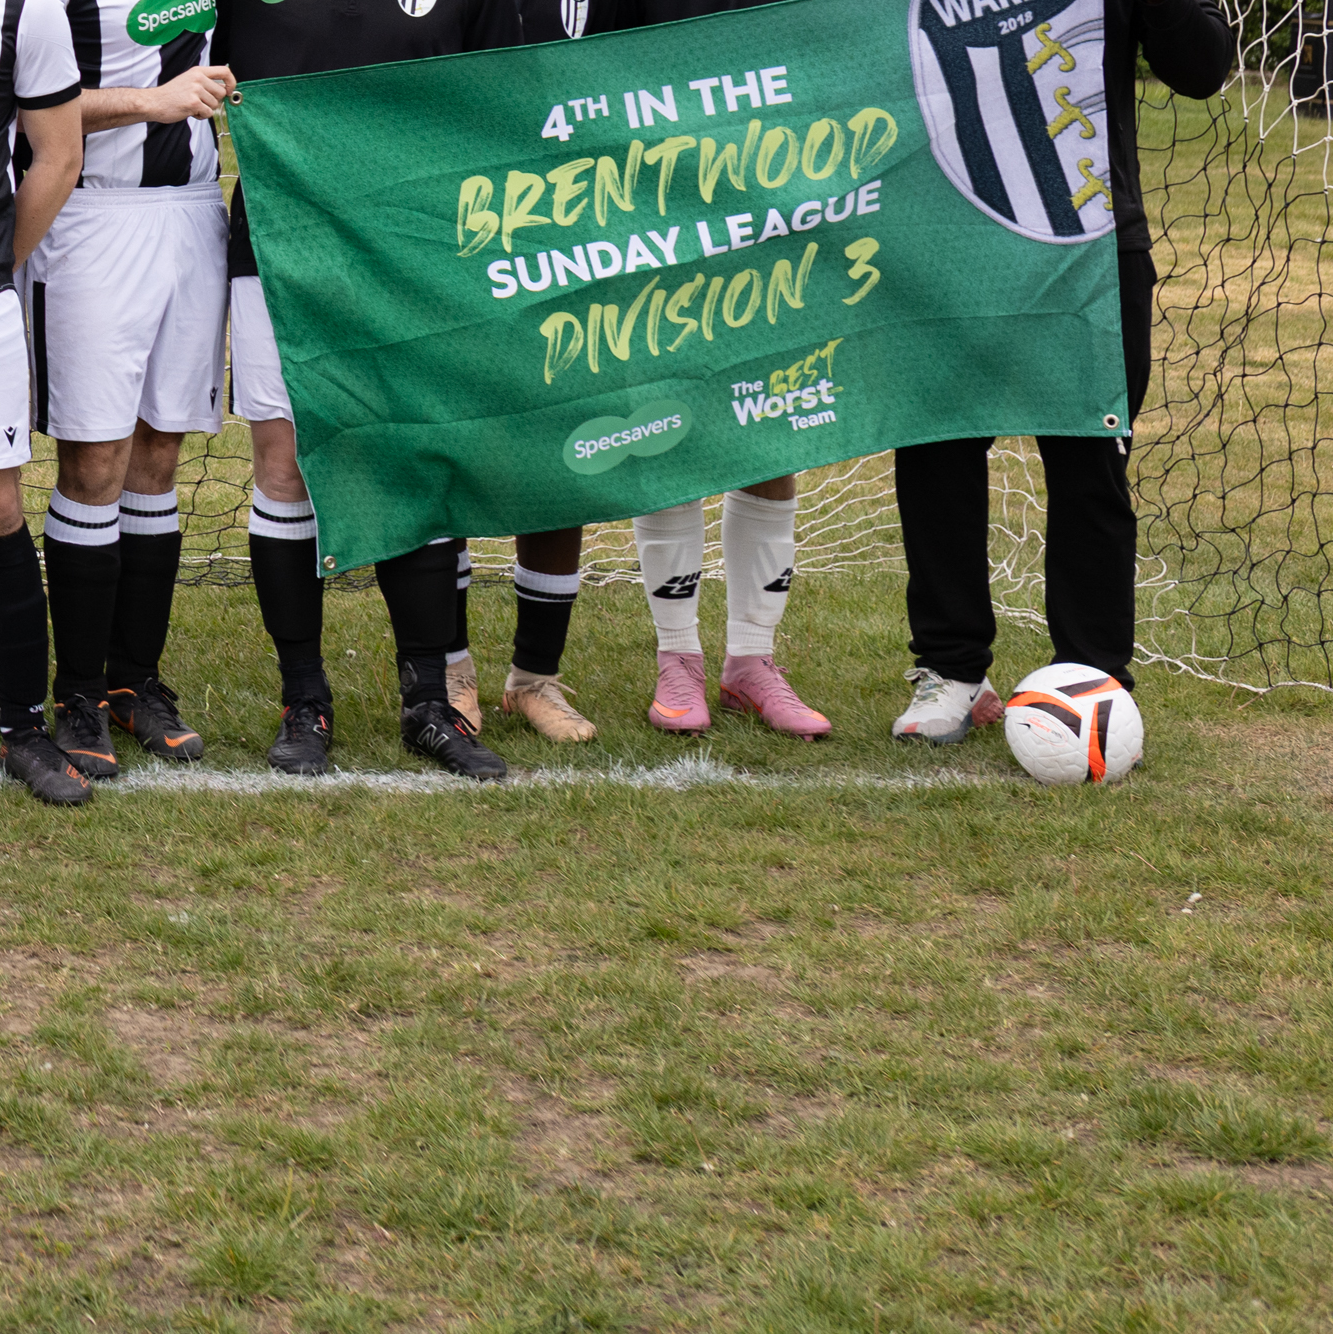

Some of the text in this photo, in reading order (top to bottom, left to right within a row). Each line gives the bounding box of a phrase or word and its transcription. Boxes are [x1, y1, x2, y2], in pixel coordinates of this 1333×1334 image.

[998, 11, 1033, 35] 2018
[623, 85, 678, 129] IN
[689, 66, 792, 116] THE
[457, 107, 898, 257] BRENTWOOD
[487, 180, 882, 299] SUNDAY LEAGUE
[539, 237, 881, 385] DIVISION 3
[731, 338, 844, 397] The BEST
[731, 378, 835, 426] Worst
[788, 410, 836, 431] Team
[574, 414, 682, 458] Specsavers
